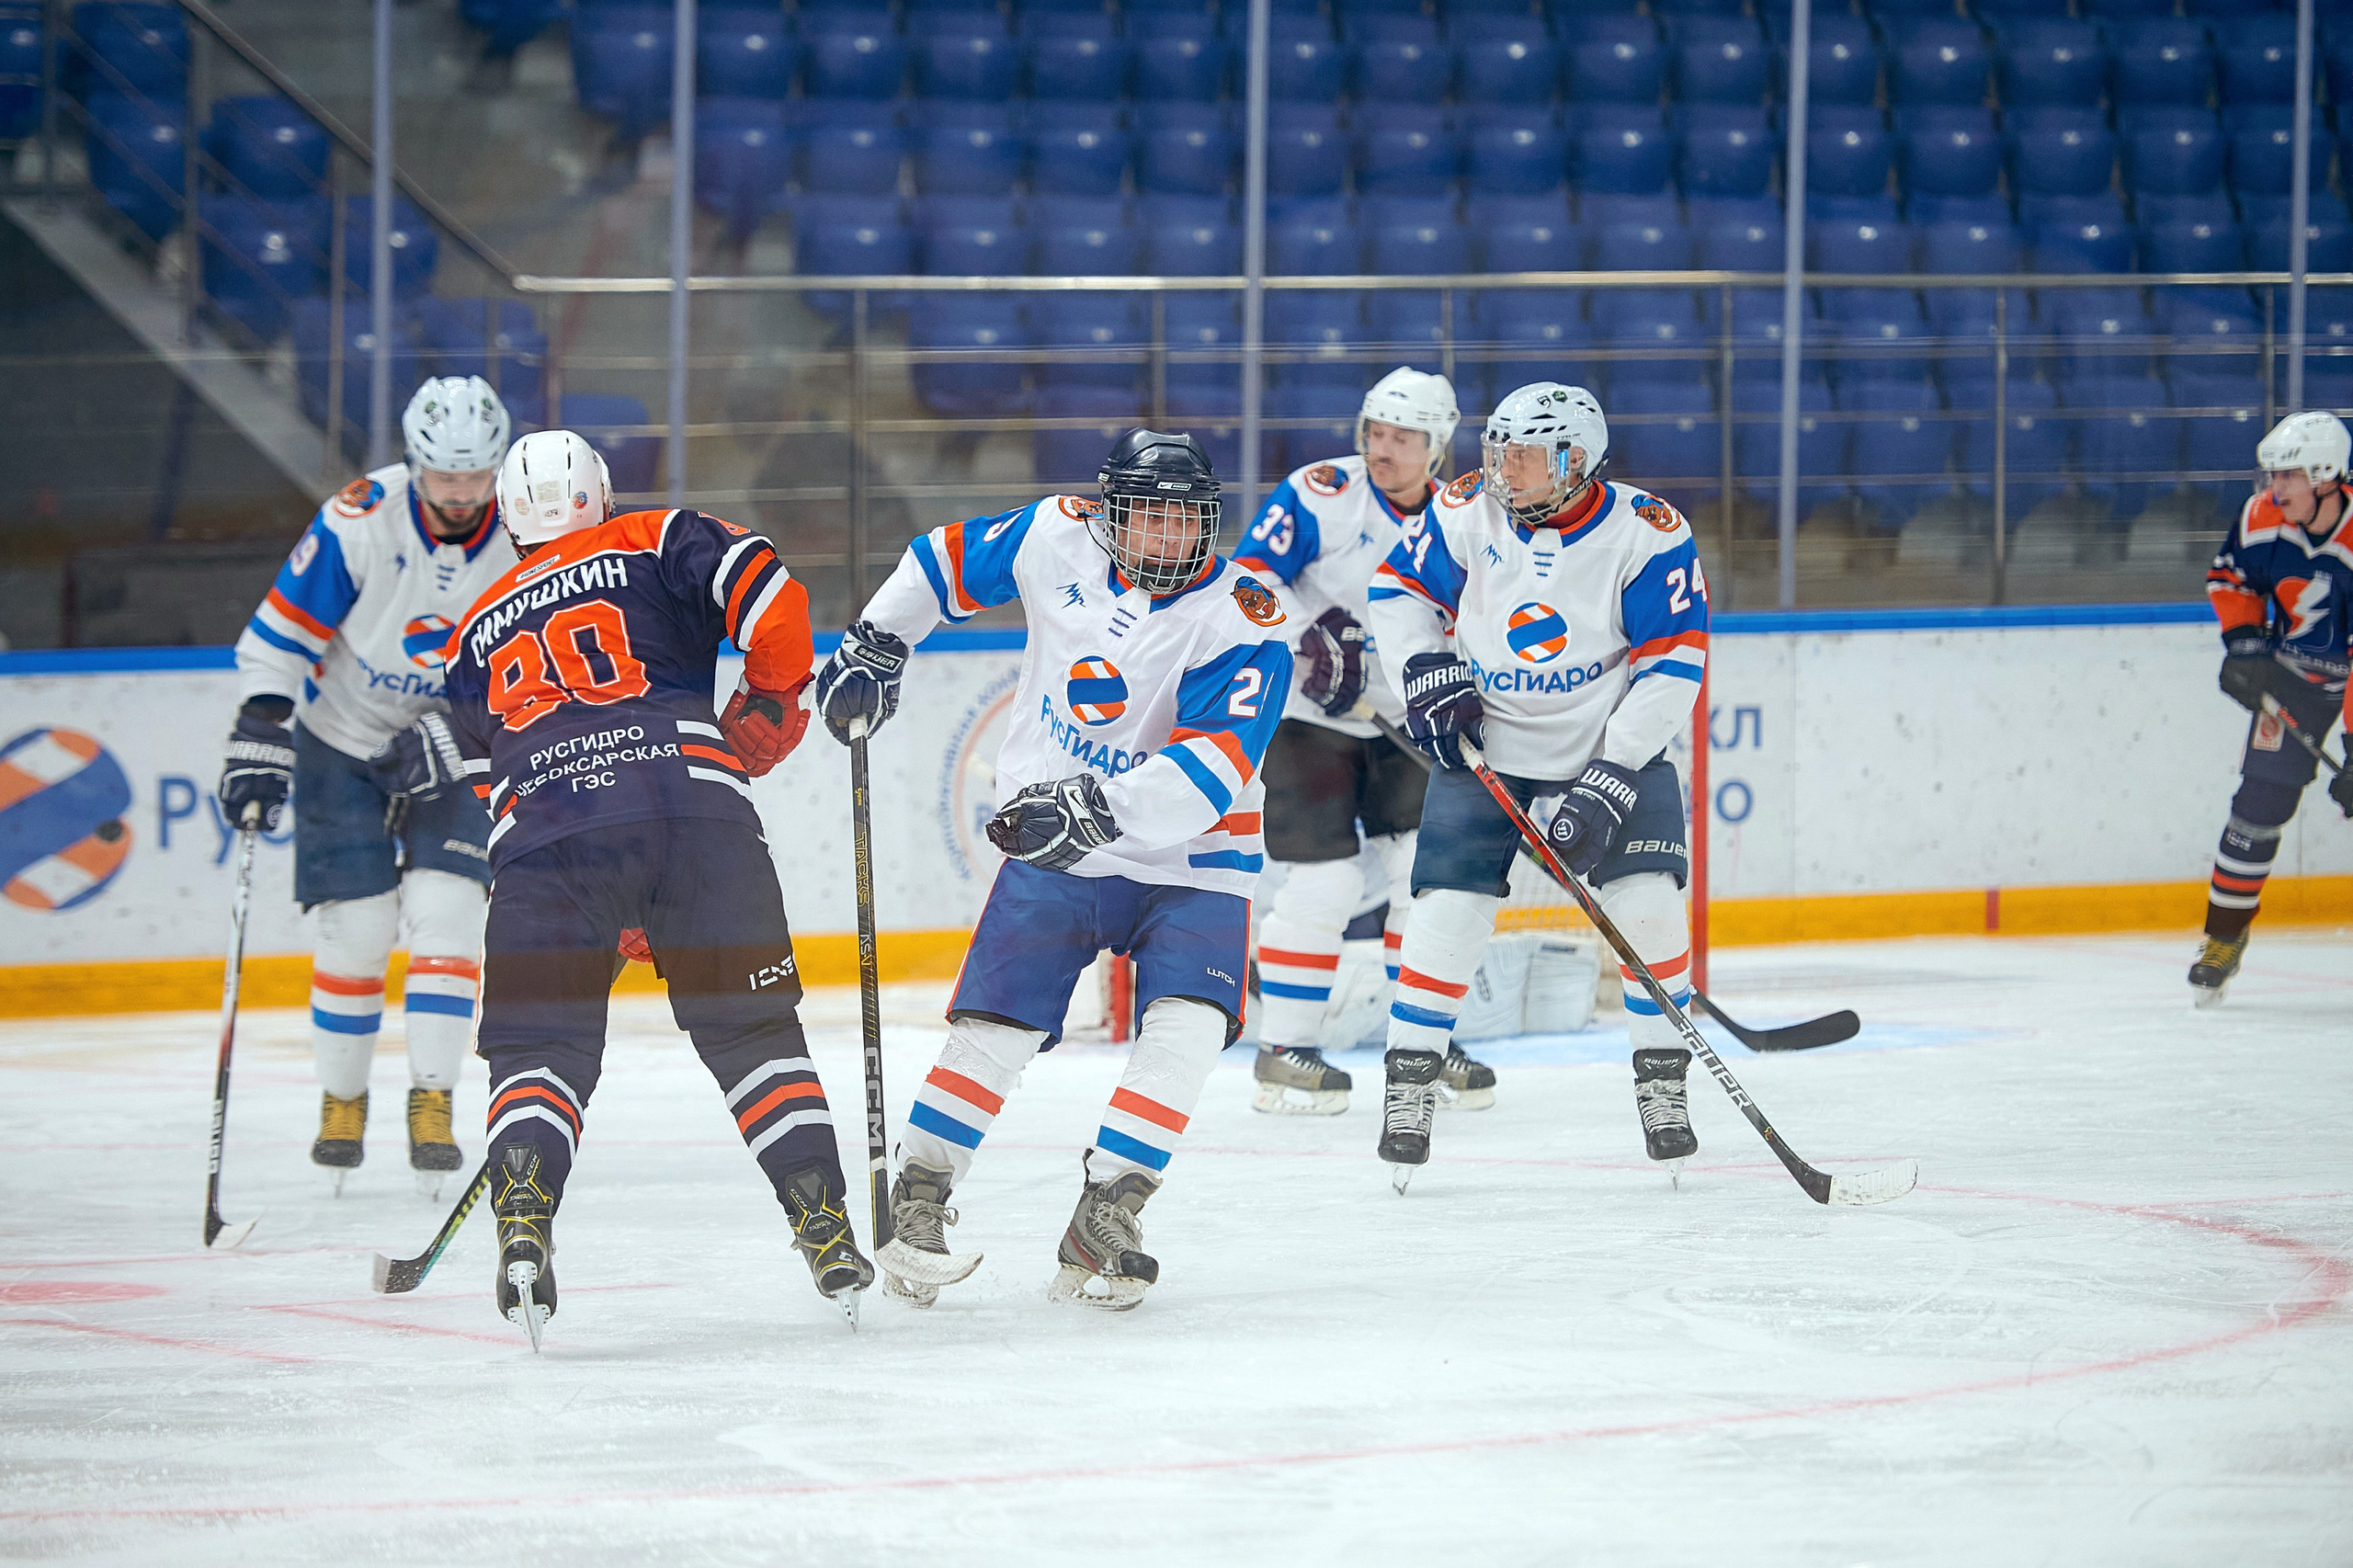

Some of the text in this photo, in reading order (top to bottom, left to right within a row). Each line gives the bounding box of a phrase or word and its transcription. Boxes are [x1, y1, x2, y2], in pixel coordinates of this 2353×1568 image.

[1251, 503, 1295, 557] 33
[470, 557, 629, 668] СИМУШКИН
[1665, 556, 1708, 616] 24
[487, 598, 653, 733] 80
[1406, 665, 1474, 701] WARRIO
[1472, 657, 1602, 694] РусГидро
[1228, 665, 1275, 722] 2
[529, 725, 645, 771] РУСГИДРО
[1040, 693, 1148, 778] РусГидро
[515, 743, 681, 798] ЧЕБОКСАРСКАЯ
[571, 770, 617, 793] ГЭС
[1207, 967, 1236, 987] LUTCH
[864, 1046, 884, 1148] CCM
[526, 1153, 539, 1176] CCM
[790, 1188, 808, 1209] CCM
